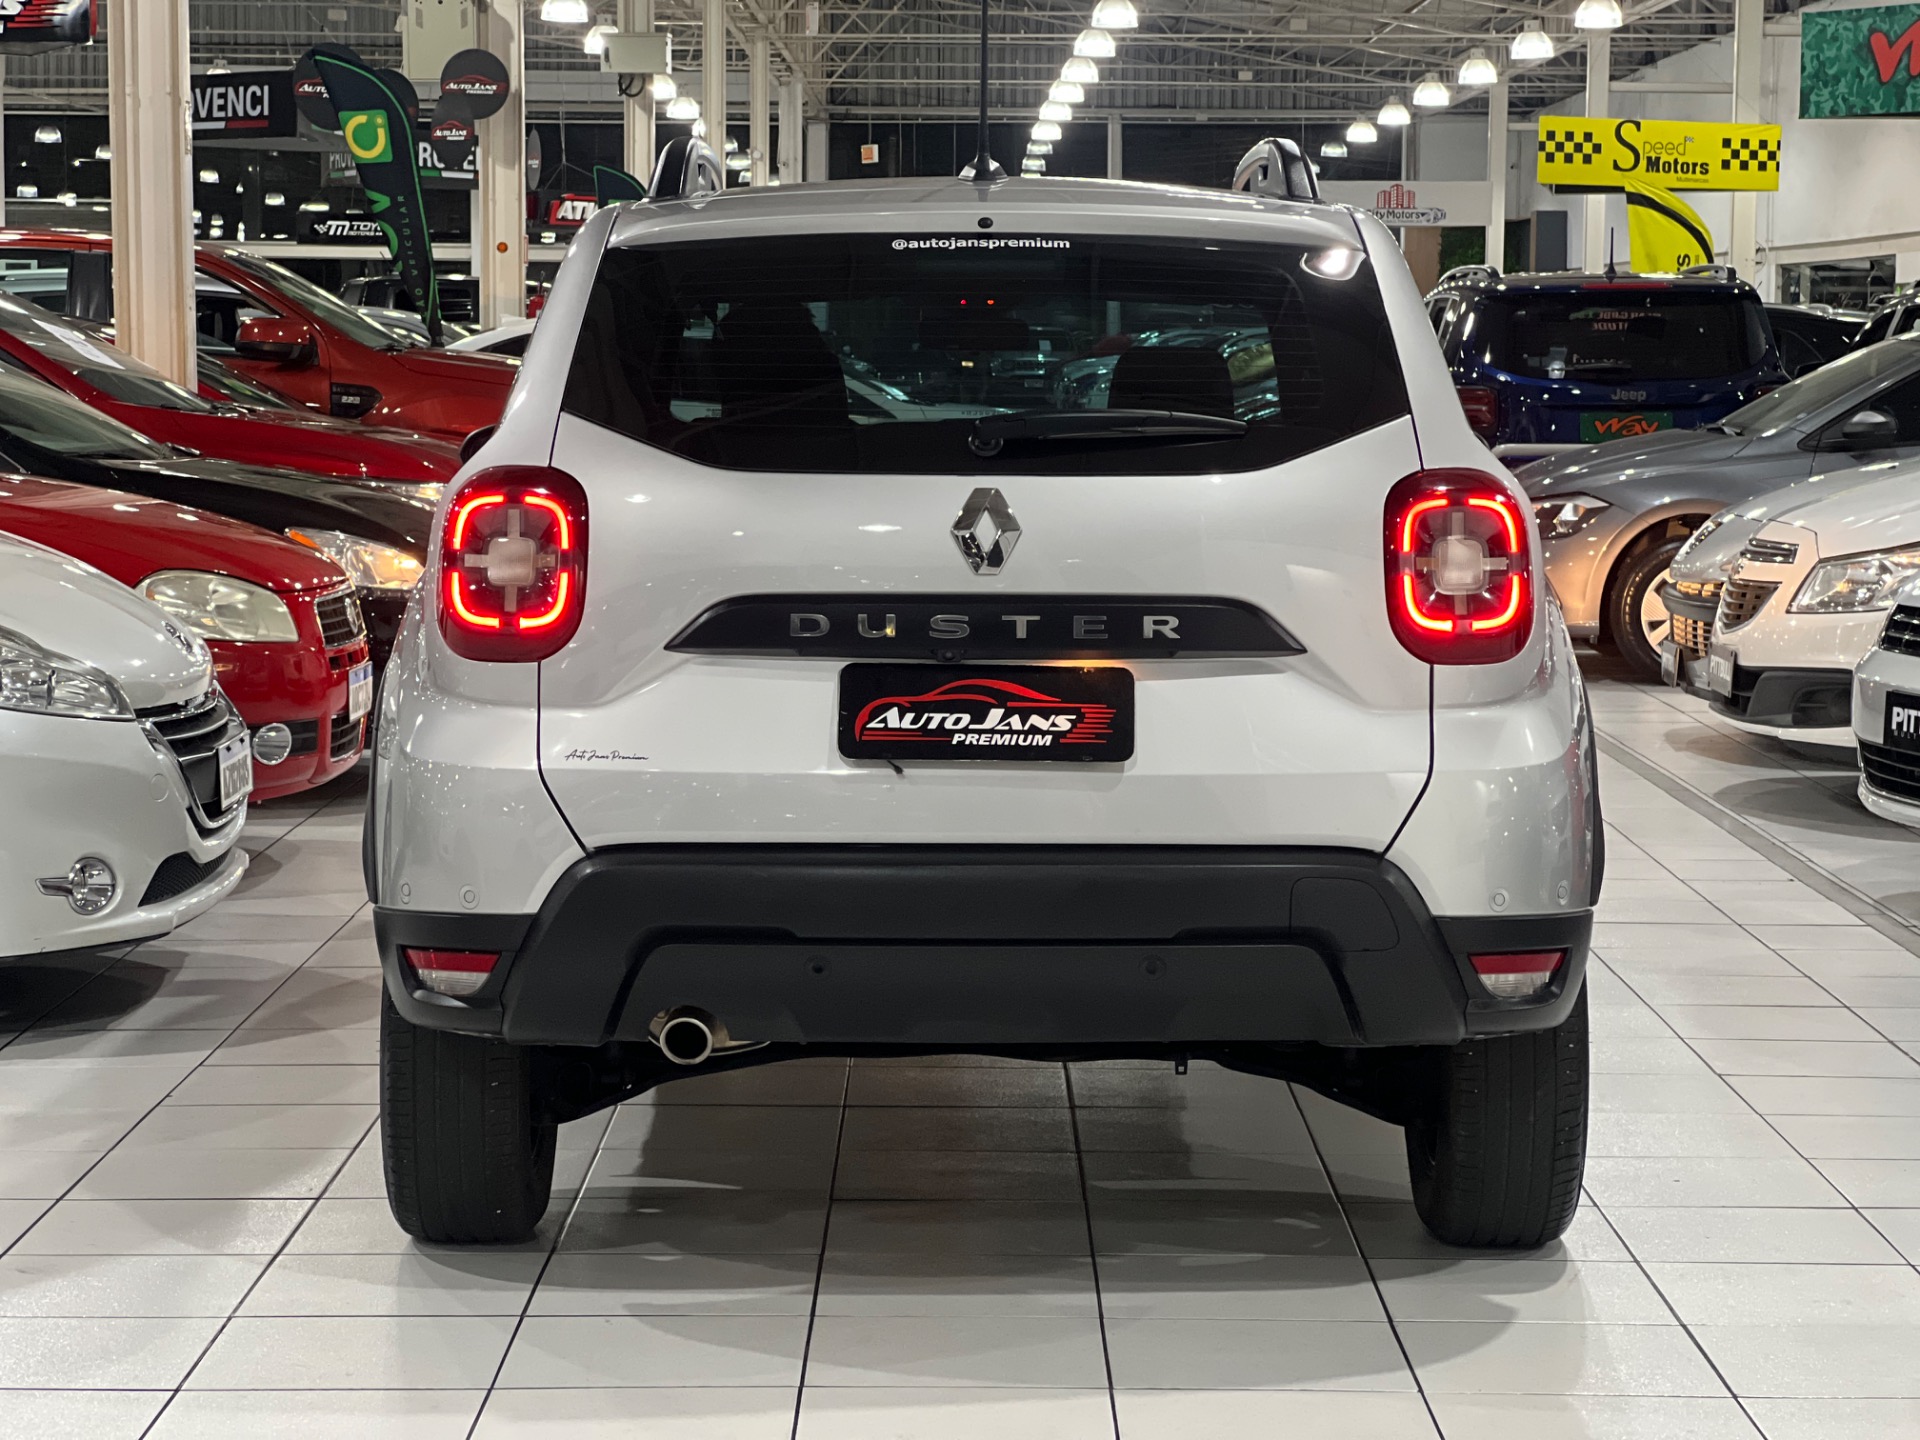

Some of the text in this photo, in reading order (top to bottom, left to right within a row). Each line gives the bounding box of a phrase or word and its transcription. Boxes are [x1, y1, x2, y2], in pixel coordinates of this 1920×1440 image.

[191, 84, 269, 118] VENCI
[1645, 156, 1709, 175] Motors
[1387, 210, 1421, 219] Motors
[398, 196, 418, 276] VEICULAR
[891, 237, 1071, 250] @autojanspremium
[1611, 389, 1647, 401] Jeep
[789, 613, 1181, 639] DUSTER
[951, 733, 1053, 746] PREMIUM
[565, 748, 589, 761] Auto
